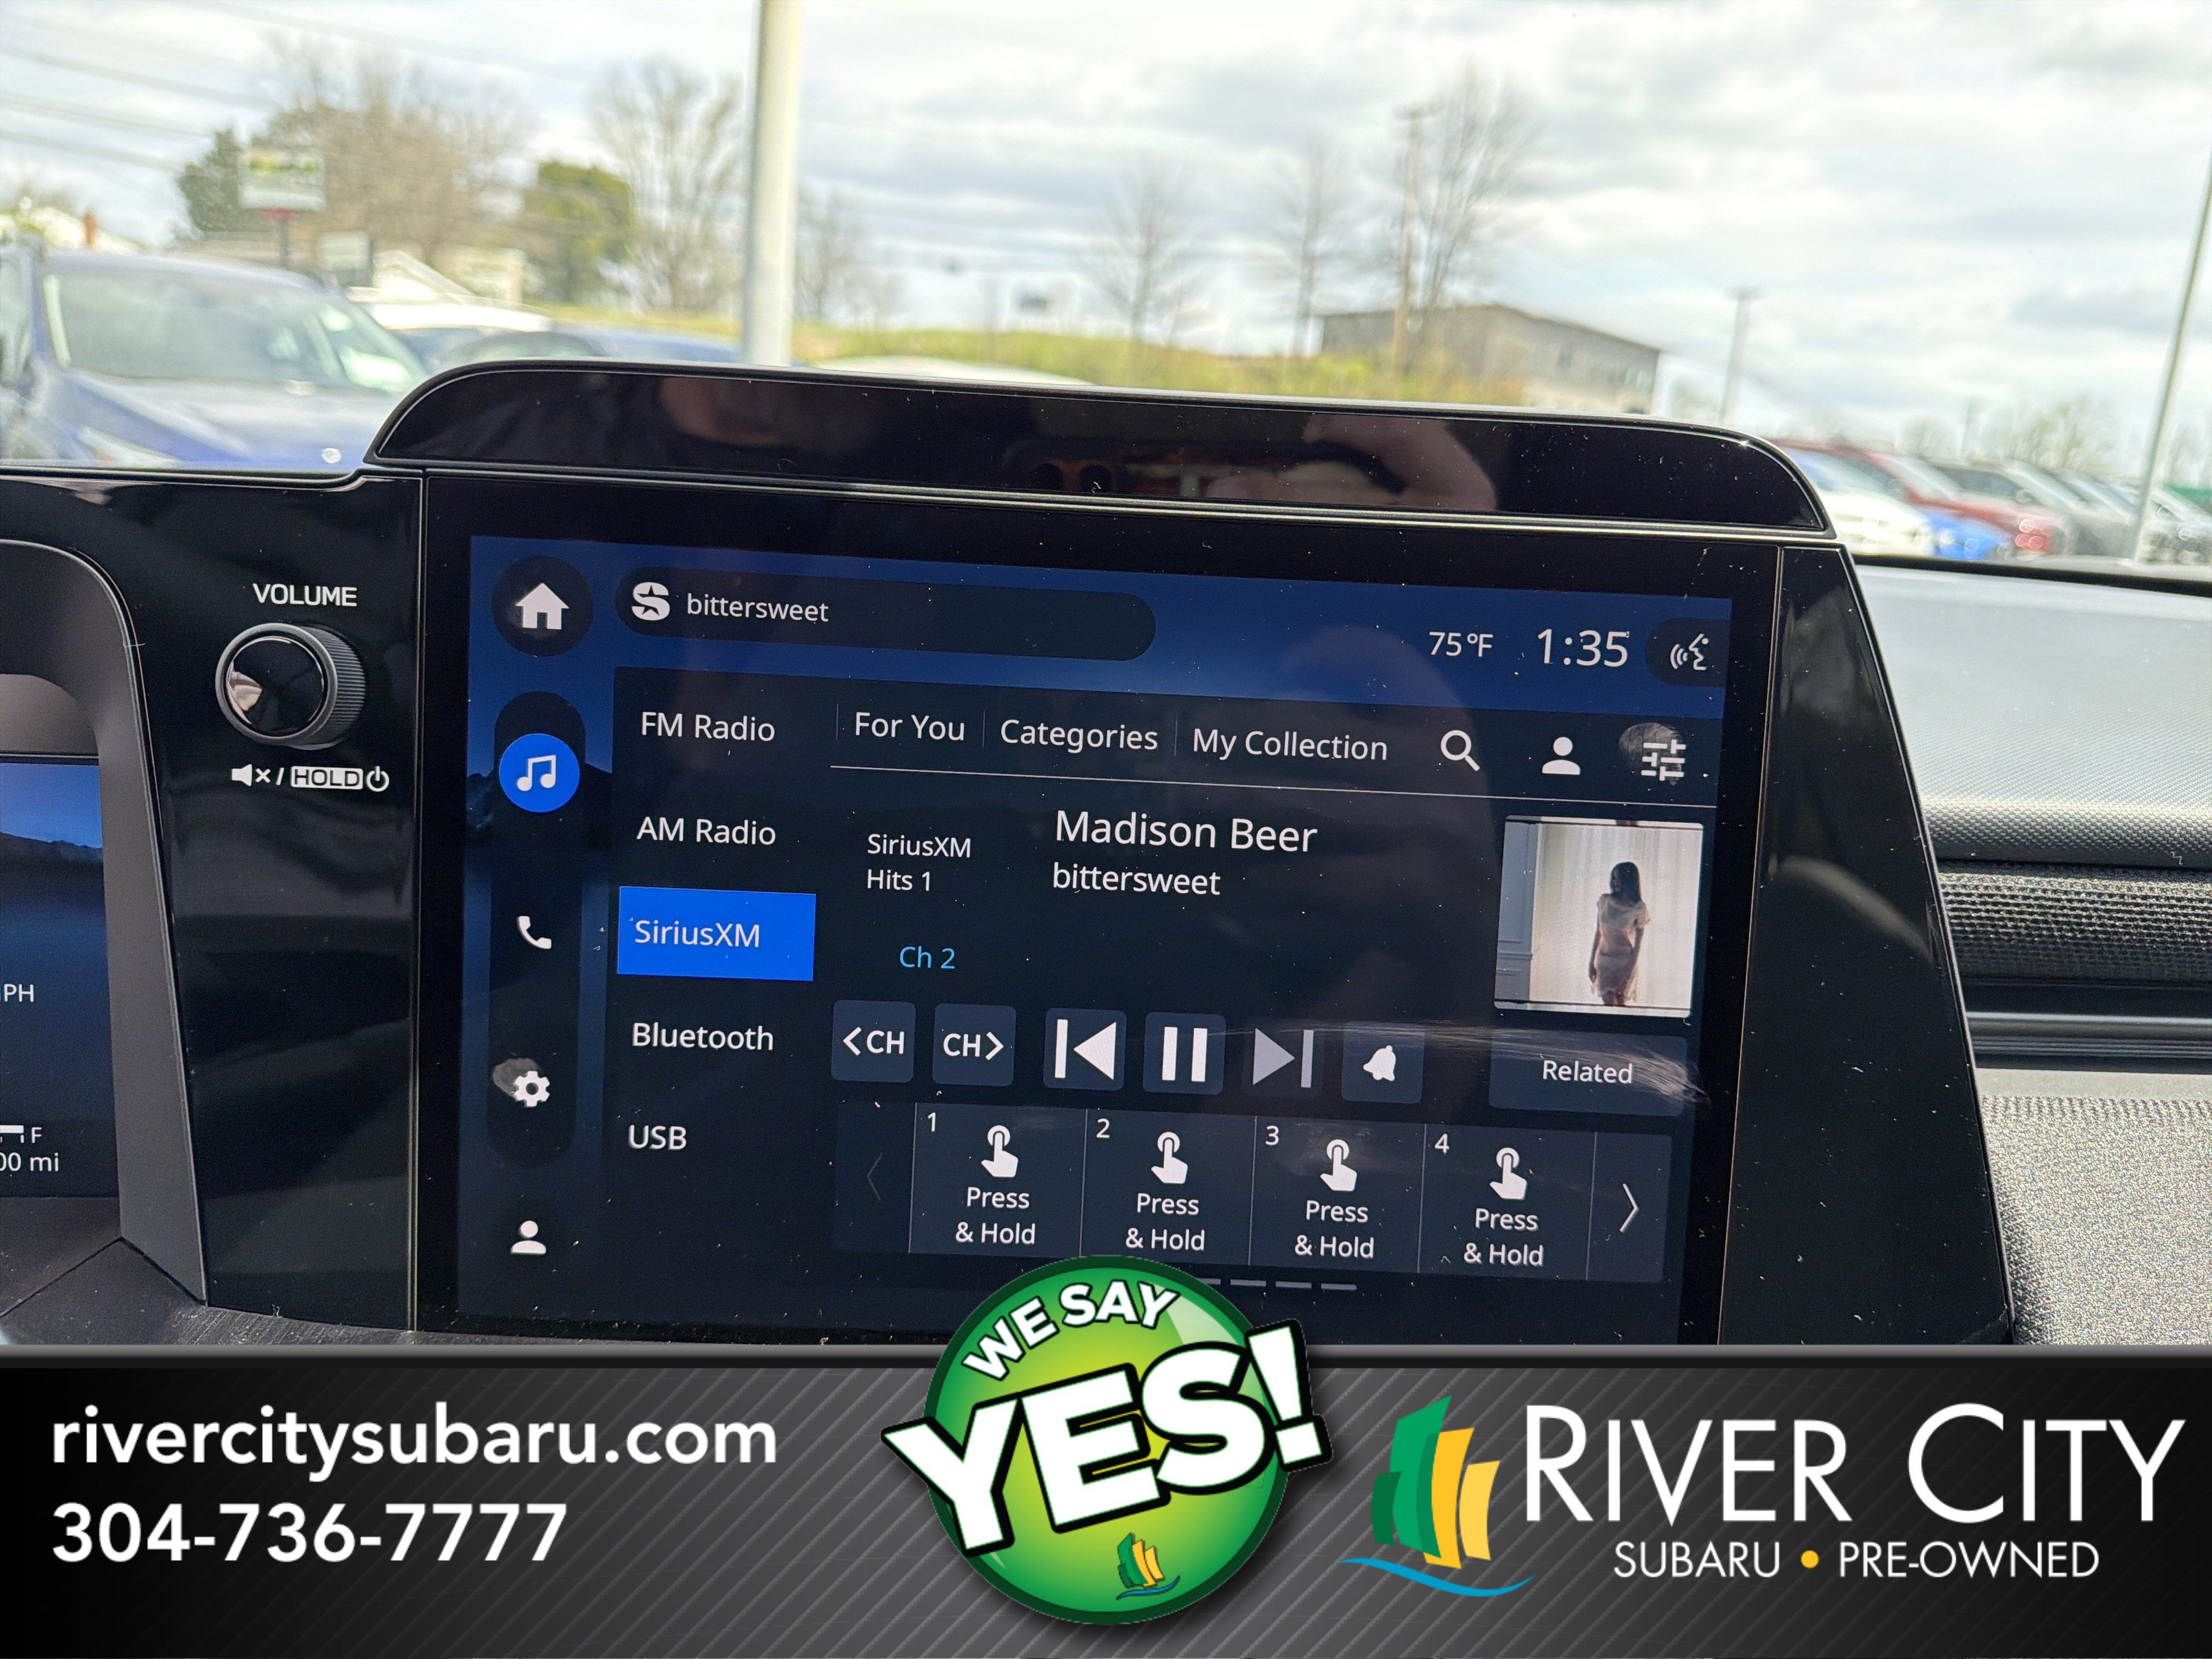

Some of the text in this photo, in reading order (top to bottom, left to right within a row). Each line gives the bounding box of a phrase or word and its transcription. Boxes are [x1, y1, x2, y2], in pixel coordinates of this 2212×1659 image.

[252, 582, 358, 607] VOLUME
[687, 592, 830, 623] bittersweet
[1537, 628, 1630, 668] 1:35
[641, 711, 776, 742] FM Radio
[855, 711, 965, 741] For You
[1000, 719, 1158, 754] Categories
[1193, 727, 1387, 761] My Collection
[293, 767, 362, 788] HOLD
[635, 816, 776, 846] AM Radio
[1056, 809, 1318, 853] Madison Beer
[867, 833, 972, 859] SiriusXM
[867, 868, 930, 892] Hits 1
[1053, 861, 1221, 896] bittersweet
[634, 919, 760, 948] SiriusXM
[899, 945, 956, 970] Ch 2
[0, 983, 35, 1003] PH
[632, 1021, 774, 1051] Bluetooth
[1542, 1059, 1634, 1085] Related
[927, 1111, 936, 1133] 1
[1096, 1118, 1110, 1139] 2
[31, 1126, 43, 1144] F
[629, 1124, 687, 1150] USB
[1265, 1125, 1280, 1146] 3
[1434, 1133, 1450, 1154] 4
[29, 1152, 59, 1172] mi
[966, 1186, 1030, 1210] Press
[1136, 1192, 1200, 1216] Press
[1305, 1199, 1369, 1223] Press
[1475, 1207, 1539, 1231] Press
[955, 1221, 1036, 1245] & Hold
[1125, 1227, 1205, 1251] & Hold
[1294, 1234, 1375, 1259] & Hold
[1463, 1242, 1544, 1267] & Hold
